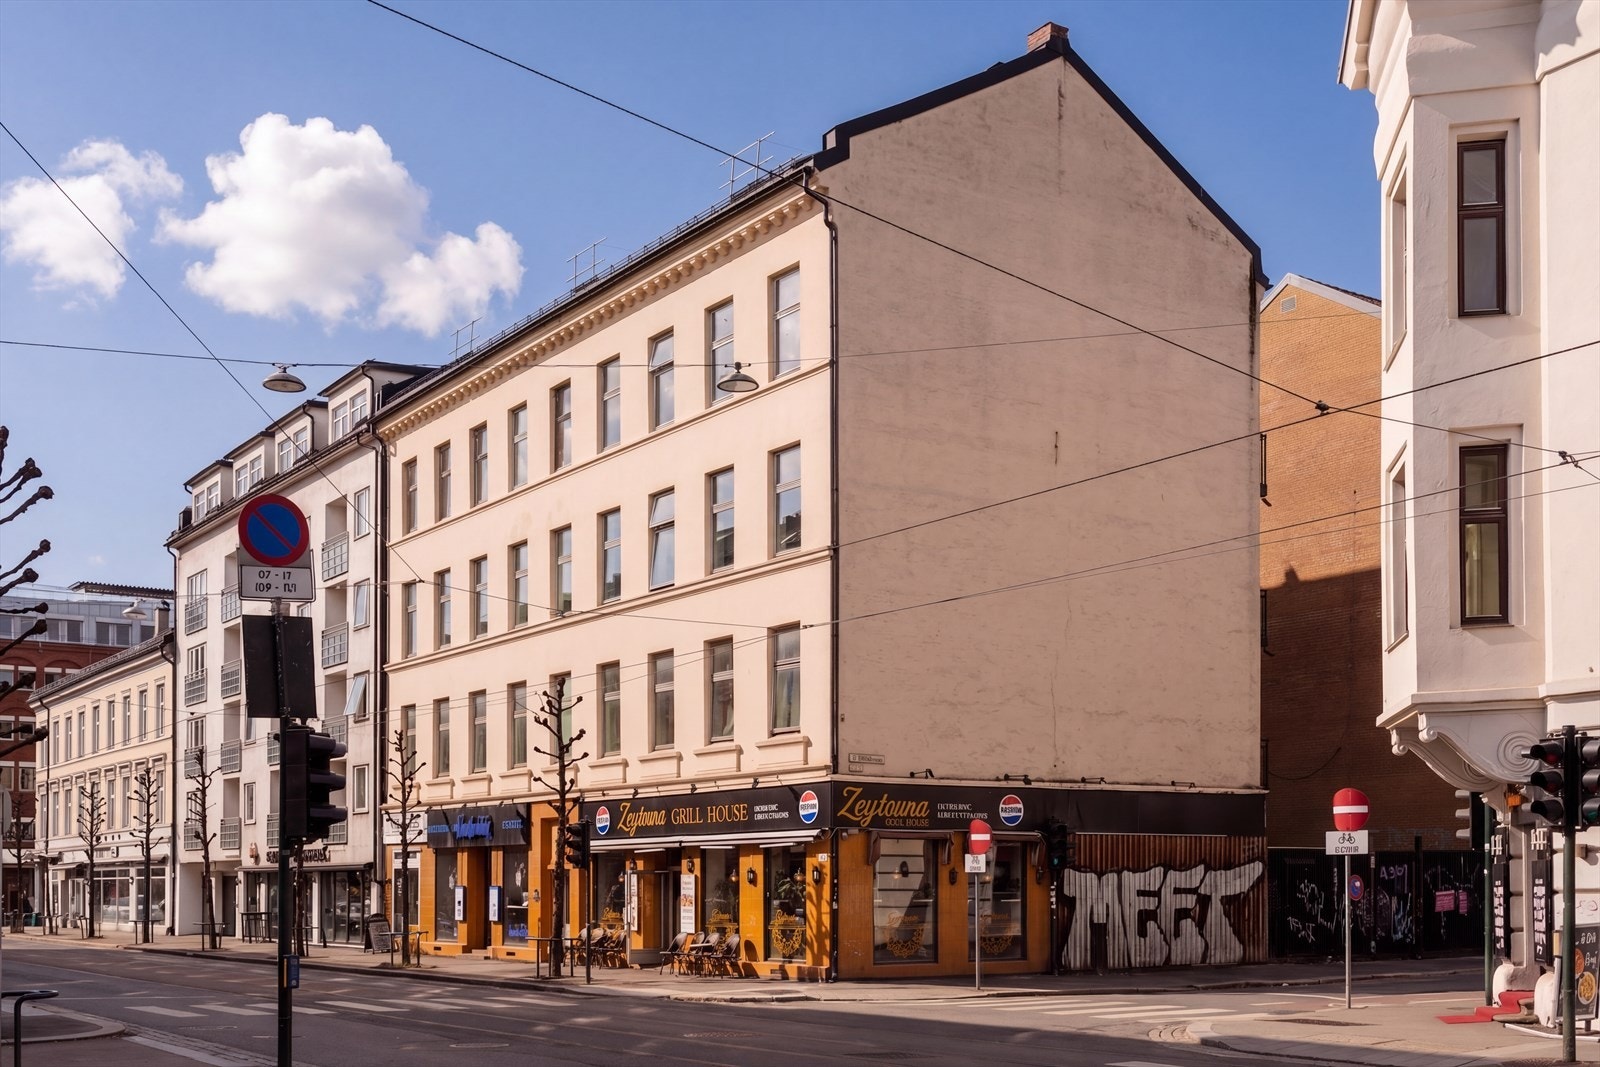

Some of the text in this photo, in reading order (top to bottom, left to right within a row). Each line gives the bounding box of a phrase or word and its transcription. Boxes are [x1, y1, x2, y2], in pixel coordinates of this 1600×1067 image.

[258, 570, 271, 579] 07
[283, 571, 291, 580] 17
[617, 802, 748, 837] Zeytouna GRILL HOUSE
[837, 786, 929, 827] Zeytouna
